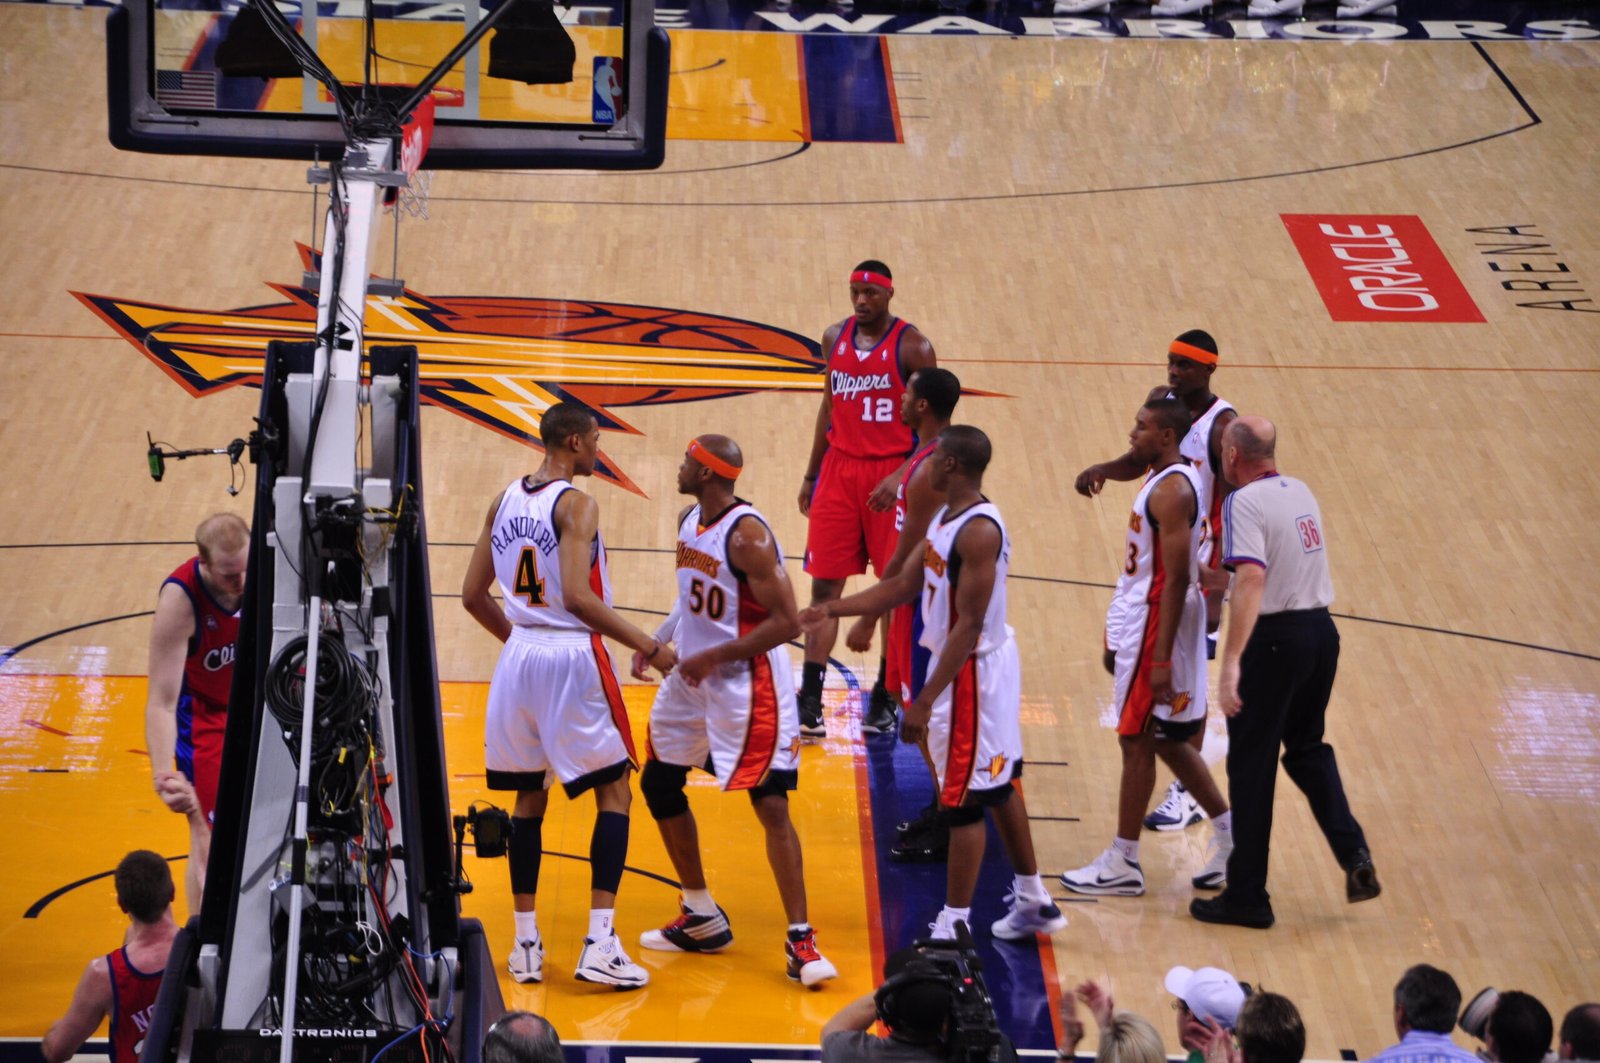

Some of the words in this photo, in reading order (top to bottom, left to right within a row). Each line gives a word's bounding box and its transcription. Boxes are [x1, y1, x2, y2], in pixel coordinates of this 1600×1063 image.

[754, 11, 1600, 39] WARRIORS
[1319, 223, 1439, 311] ORACLE
[1465, 224, 1600, 313] ARENA
[831, 369, 892, 401] Clippers
[861, 396, 893, 422] 12
[490, 516, 558, 557] RANDOLPH
[1299, 519, 1320, 548] 36
[512, 545, 549, 607] 4
[689, 577, 726, 621] 50
